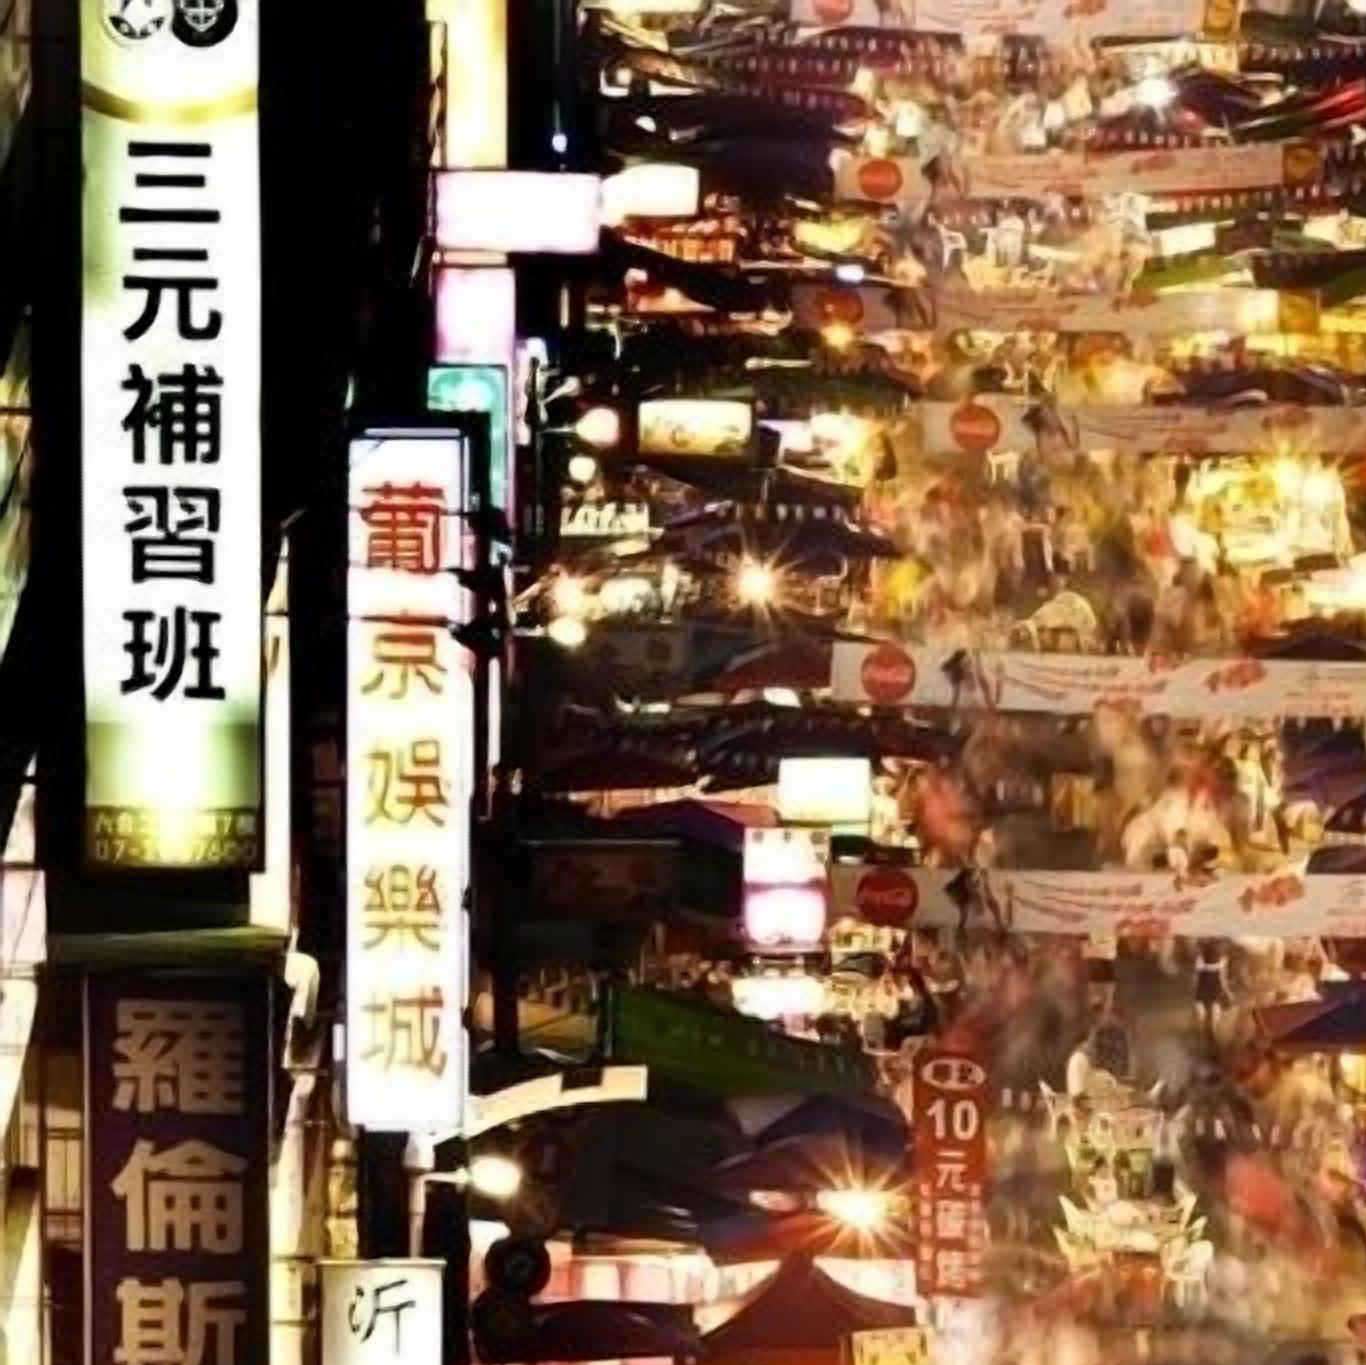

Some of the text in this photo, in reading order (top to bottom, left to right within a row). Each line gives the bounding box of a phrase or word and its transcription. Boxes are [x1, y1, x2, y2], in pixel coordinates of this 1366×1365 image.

[119, 142, 226, 702] 三元補習班
[359, 481, 449, 1081] 葡京娛樂城
[926, 1100, 979, 1141] 10
